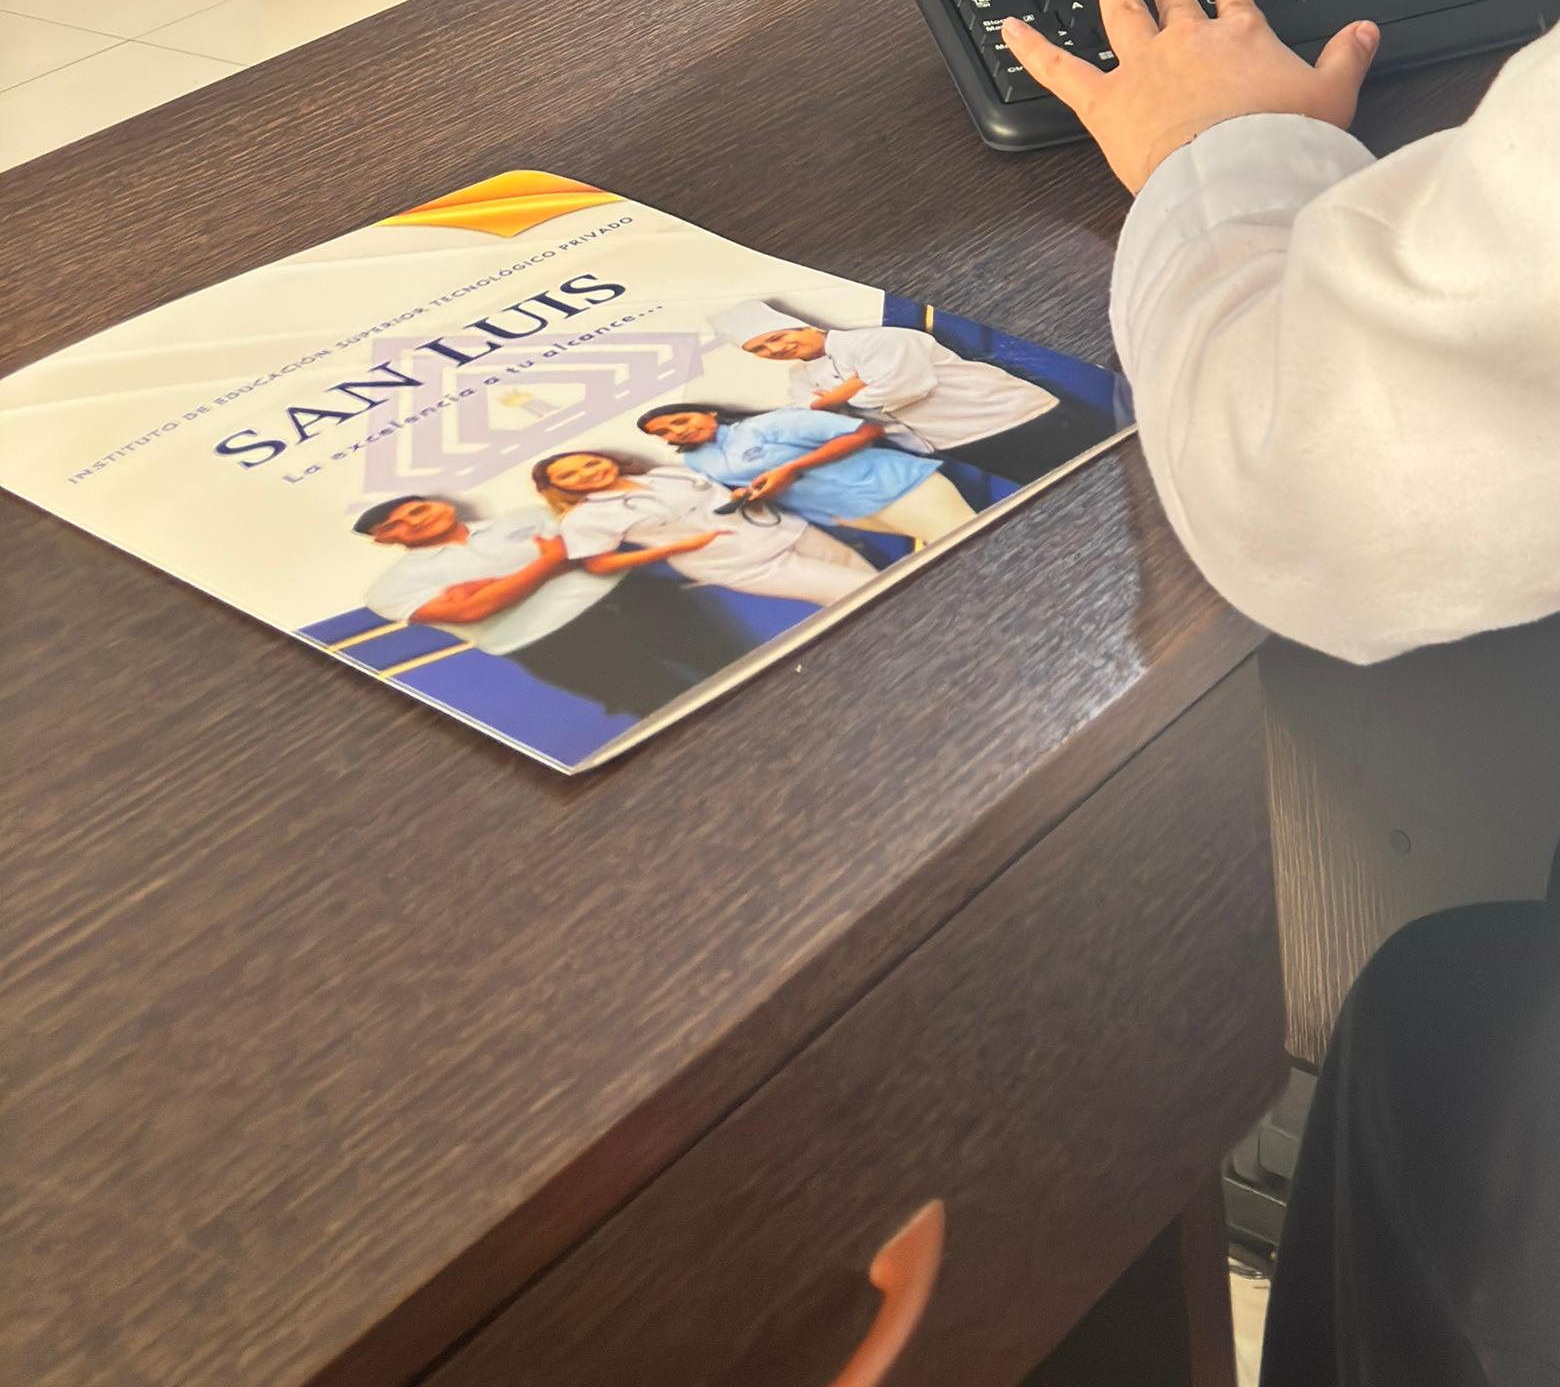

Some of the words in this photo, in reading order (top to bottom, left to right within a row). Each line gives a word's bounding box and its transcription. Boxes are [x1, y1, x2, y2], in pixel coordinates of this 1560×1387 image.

[68, 419, 179, 485] INSTITUTO
[182, 404, 212, 422] DE
[214, 347, 332, 406] EDUCACIÓN
[335, 306, 430, 349] SUPERIOR
[429, 249, 557, 307] TECNOLÓGICO
[558, 216, 634, 251] PRIVADO
[212, 360, 424, 469] SAN
[414, 273, 627, 368] LUIS
[282, 461, 321, 485] La
[330, 386, 476, 461] excelencia
[483, 375, 501, 387] a
[506, 358, 535, 375] tu
